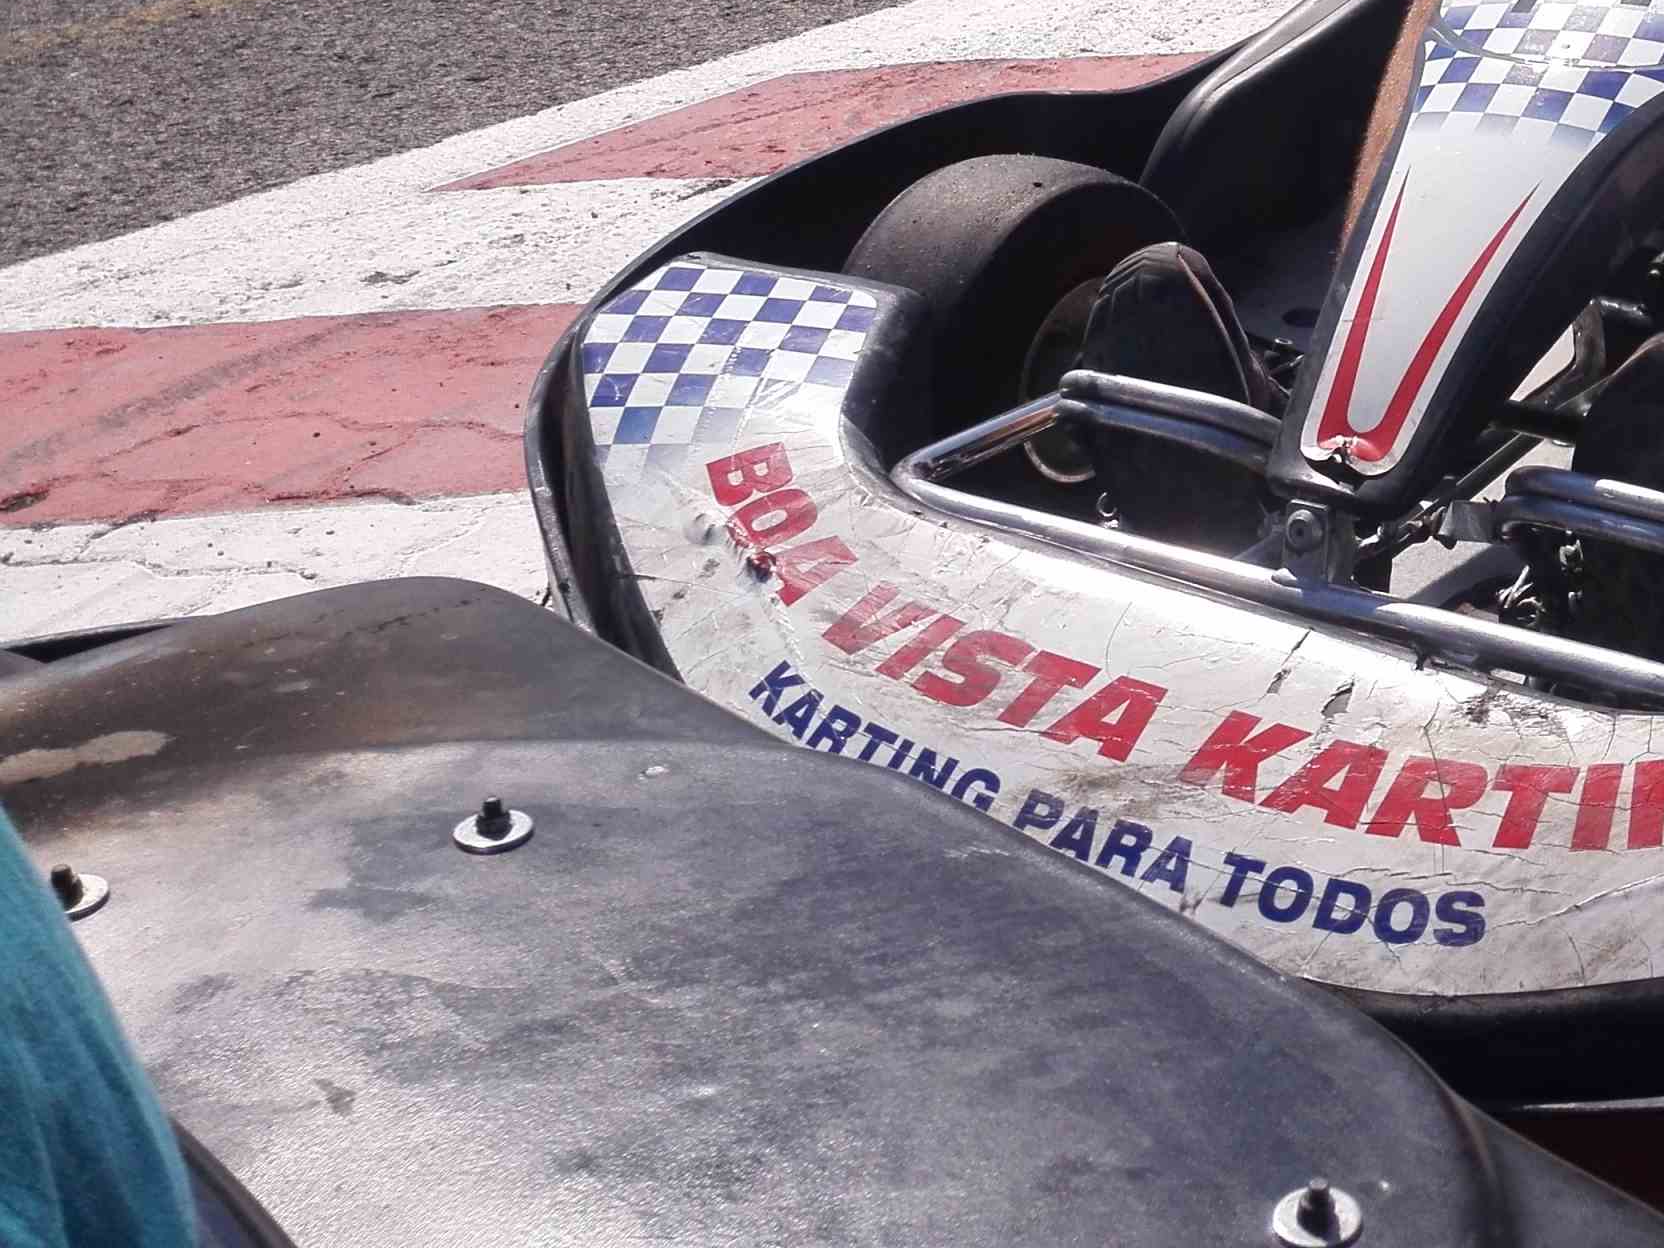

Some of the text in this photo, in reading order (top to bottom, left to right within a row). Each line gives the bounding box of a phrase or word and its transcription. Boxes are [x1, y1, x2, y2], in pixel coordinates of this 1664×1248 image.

[705, 441, 858, 608] BOA
[821, 581, 1169, 763] VISTA
[748, 659, 1487, 948] KARTING PARA TODOS
